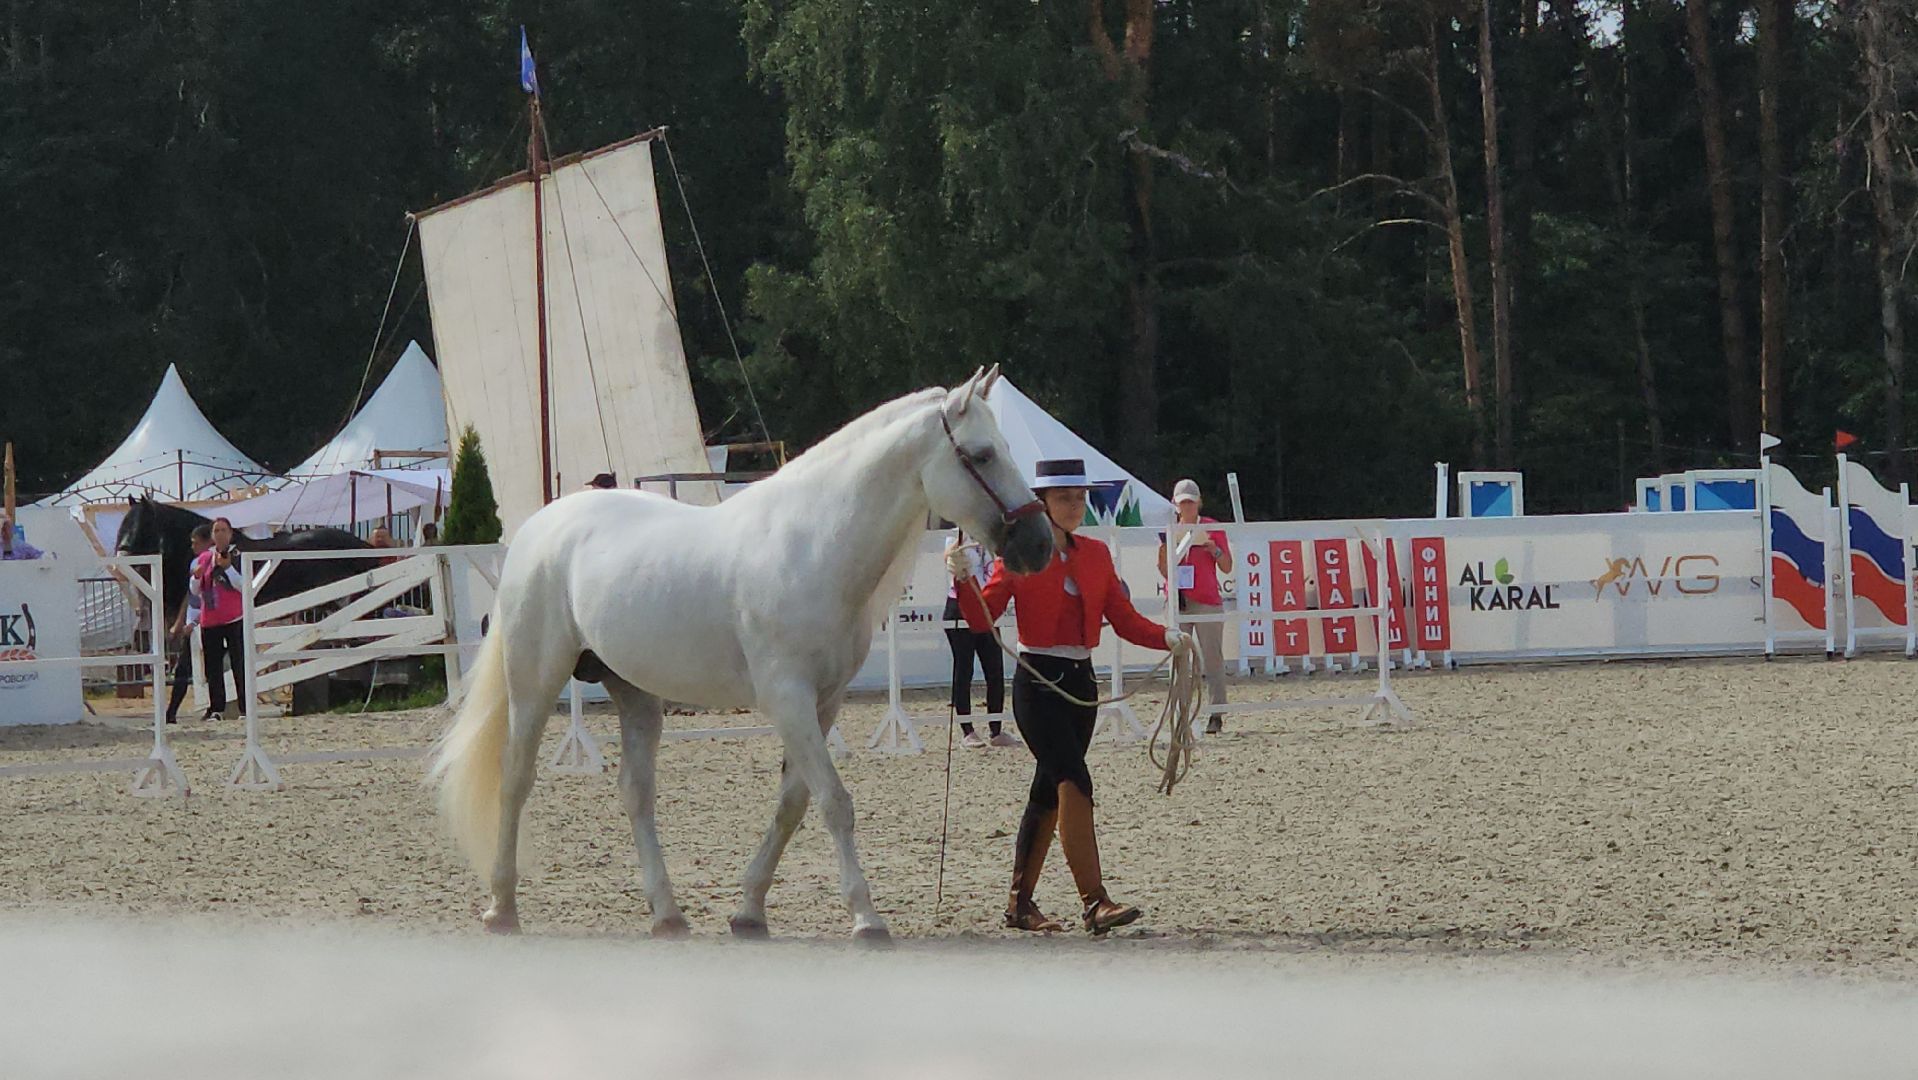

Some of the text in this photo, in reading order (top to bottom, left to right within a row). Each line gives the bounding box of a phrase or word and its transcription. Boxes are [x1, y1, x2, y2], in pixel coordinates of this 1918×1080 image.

[1280, 549, 1298, 646] СТАТ
[1324, 549, 1346, 644] СТАТ
[1421, 547, 1442, 641] ФИНИШ
